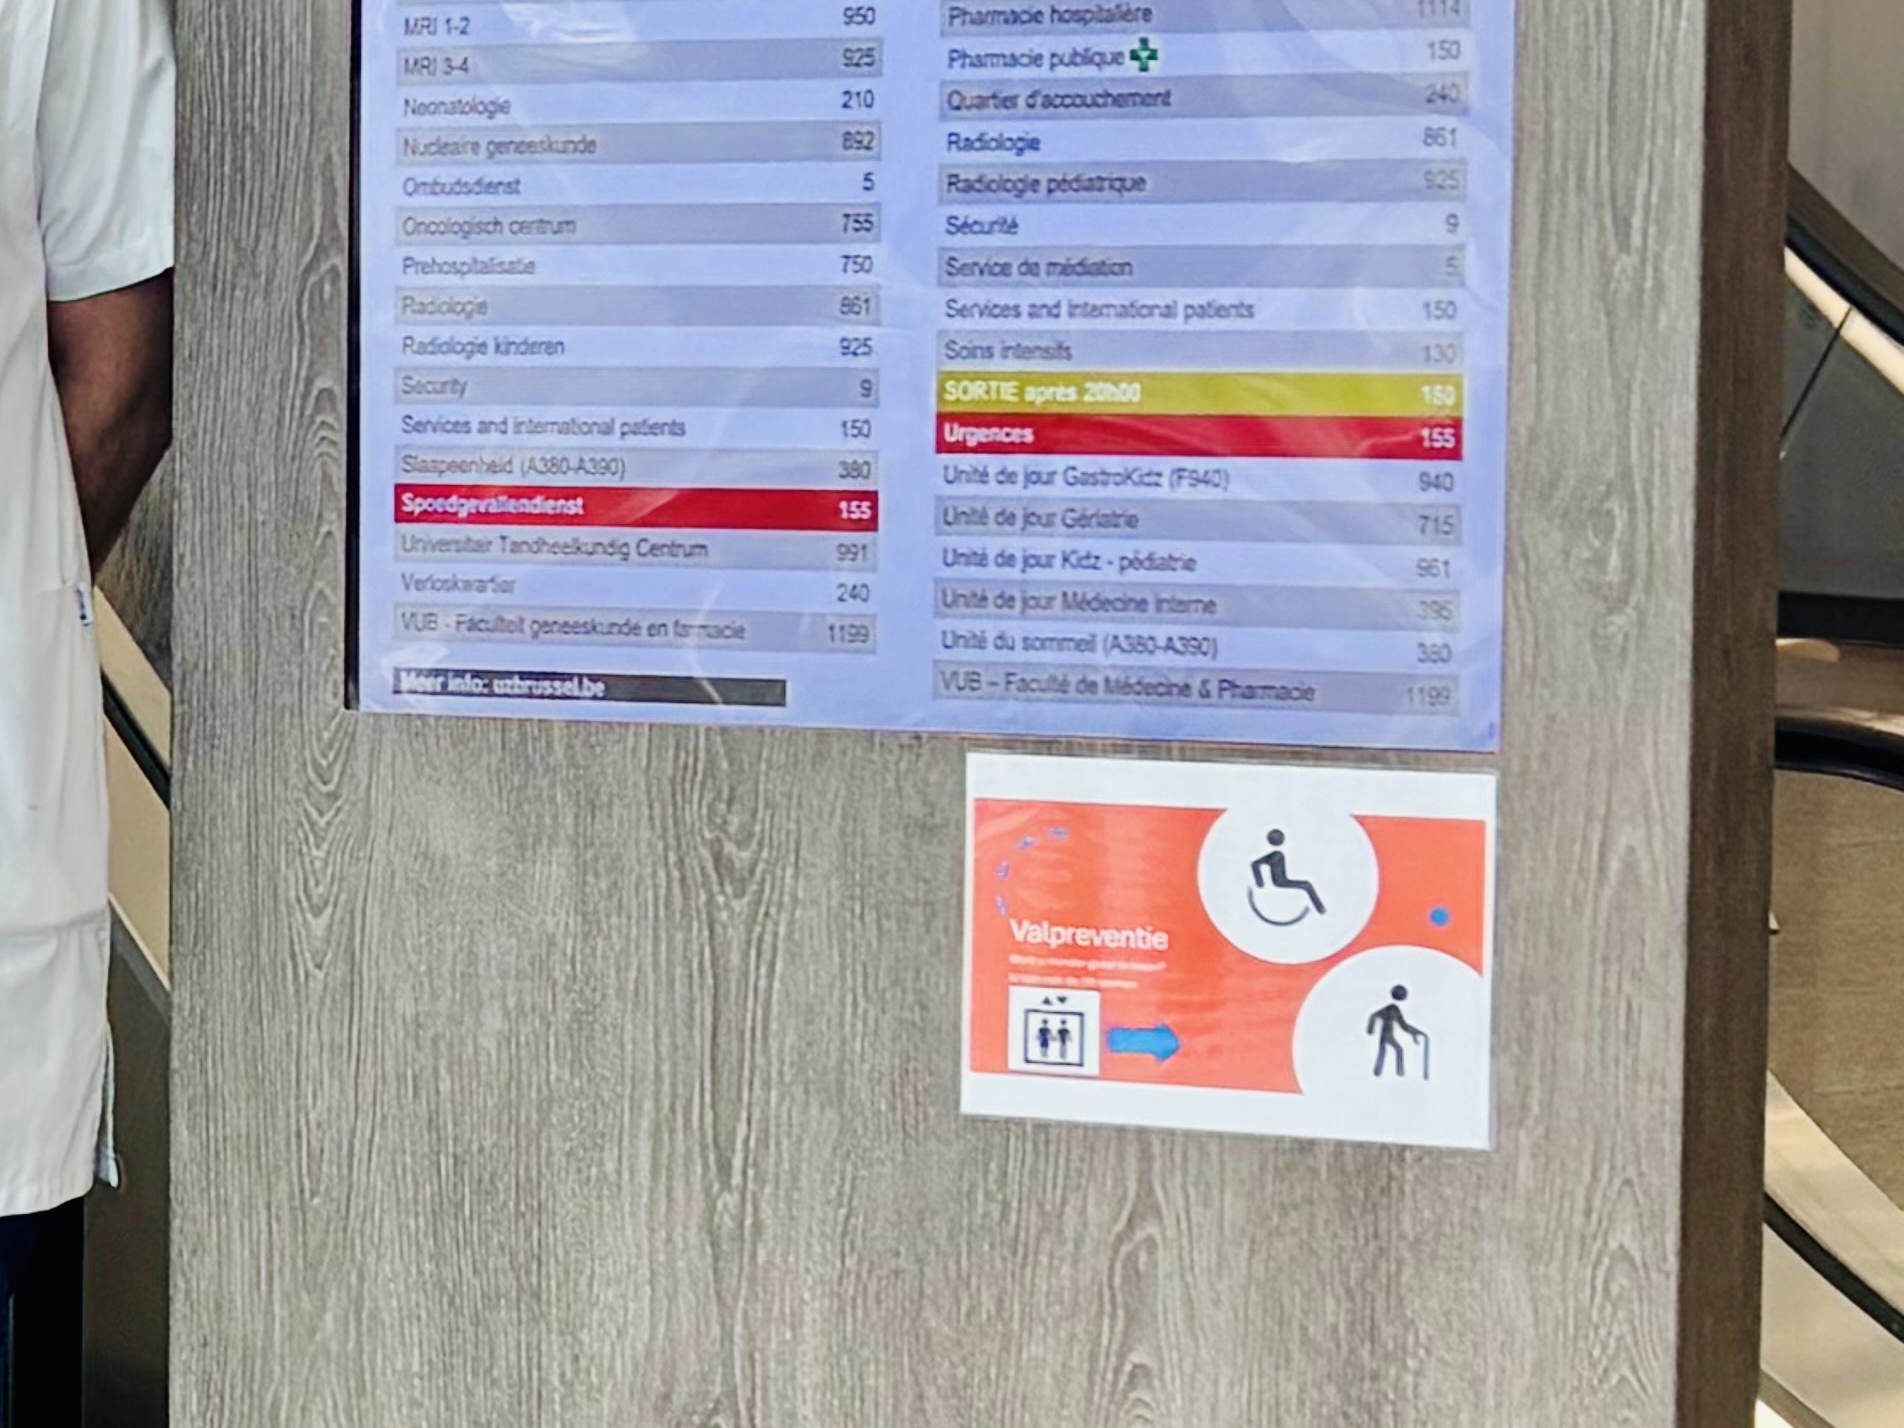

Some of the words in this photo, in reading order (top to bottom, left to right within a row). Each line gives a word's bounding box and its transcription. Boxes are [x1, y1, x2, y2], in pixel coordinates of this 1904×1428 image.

[403, 17, 438, 37] MRI
[443, 16, 471, 36] 1-2
[841, 6, 876, 27] 950
[947, 5, 1045, 27] Pharmacie
[1049, 3, 1154, 30] hospitalière
[403, 56, 438, 76] MRI
[441, 56, 471, 76] 3-4
[841, 47, 876, 68] 925
[946, 47, 1045, 68] Pharmacie
[1048, 46, 1125, 72] publique
[1426, 39, 1461, 61] 150
[403, 96, 511, 120] Neonatologie
[840, 89, 875, 110] 210
[947, 90, 1020, 110] Quartier
[1025, 88, 1173, 109] d'accouchement
[1424, 83, 1461, 104] 240
[402, 137, 481, 156] Nucleaire
[485, 135, 597, 161] geneeskunde
[839, 130, 875, 151] 892
[946, 132, 1042, 156] Radiologie
[1422, 126, 1458, 147] 861
[402, 177, 522, 196] Ombudsdienst
[861, 172, 875, 192] 5
[945, 174, 1041, 198] Radiologie
[1045, 173, 1148, 198] pédiatrique
[1422, 169, 1460, 191] 925
[402, 216, 504, 241] Oncologisch
[508, 217, 577, 236] centrum
[840, 213, 875, 233] 755
[945, 215, 1019, 236] Sécurité
[1444, 213, 1459, 234] 9
[401, 256, 536, 280] Prehospitalisatie
[839, 254, 874, 274] 750
[401, 297, 488, 321] Radiologie
[838, 296, 872, 316] 861
[401, 336, 488, 360] Radiologie
[493, 336, 566, 356] kinderen
[838, 337, 874, 357] 925
[943, 341, 995, 360] Soins
[1000, 341, 1073, 361] intensifs
[1422, 343, 1456, 363] 130
[401, 376, 468, 400] Security
[859, 378, 873, 399] 9
[944, 381, 1020, 401] SORTIE
[1024, 381, 1077, 407] après
[1082, 382, 1142, 402] 20h00
[400, 415, 472, 435] Services
[476, 416, 508, 435] and
[512, 417, 616, 436] international
[619, 418, 687, 441] patients
[839, 419, 872, 440] 150
[943, 424, 1034, 447] Urgences
[1421, 427, 1455, 448] 155
[400, 455, 514, 480] Slaapeenheid
[519, 456, 626, 482] (A380-A390)
[837, 460, 872, 480] 380
[943, 465, 990, 485] Unité
[993, 466, 1018, 485] de
[1022, 466, 1057, 491] jour
[1061, 467, 1163, 487] GastroKidz
[1168, 468, 1230, 493] (F940)
[1418, 471, 1454, 492] 940
[401, 494, 584, 518] Spoedgevallendienst
[839, 500, 872, 520] 155
[942, 507, 990, 527] Unité
[992, 507, 1017, 527] de
[1021, 508, 1056, 532] jour
[1061, 508, 1140, 529] Gériatrie
[1417, 515, 1453, 536] 715
[400, 535, 493, 555] Universitair
[499, 536, 631, 563] Tandheelkundig
[635, 539, 709, 559] Centrum
[835, 542, 869, 562] 991
[400, 574, 517, 594] Verloskwartier
[835, 582, 870, 603] 240
[940, 630, 989, 650] Unité
[992, 631, 1016, 651] du
[1020, 634, 1097, 653] sommeil
[1102, 634, 1218, 661] (A380-A390)
[1416, 643, 1453, 665] 380
[399, 673, 441, 691] Meer
[446, 674, 489, 693] info:
[493, 676, 605, 696] uzbrussel.be
[1009, 917, 1170, 951] Valpreventie
